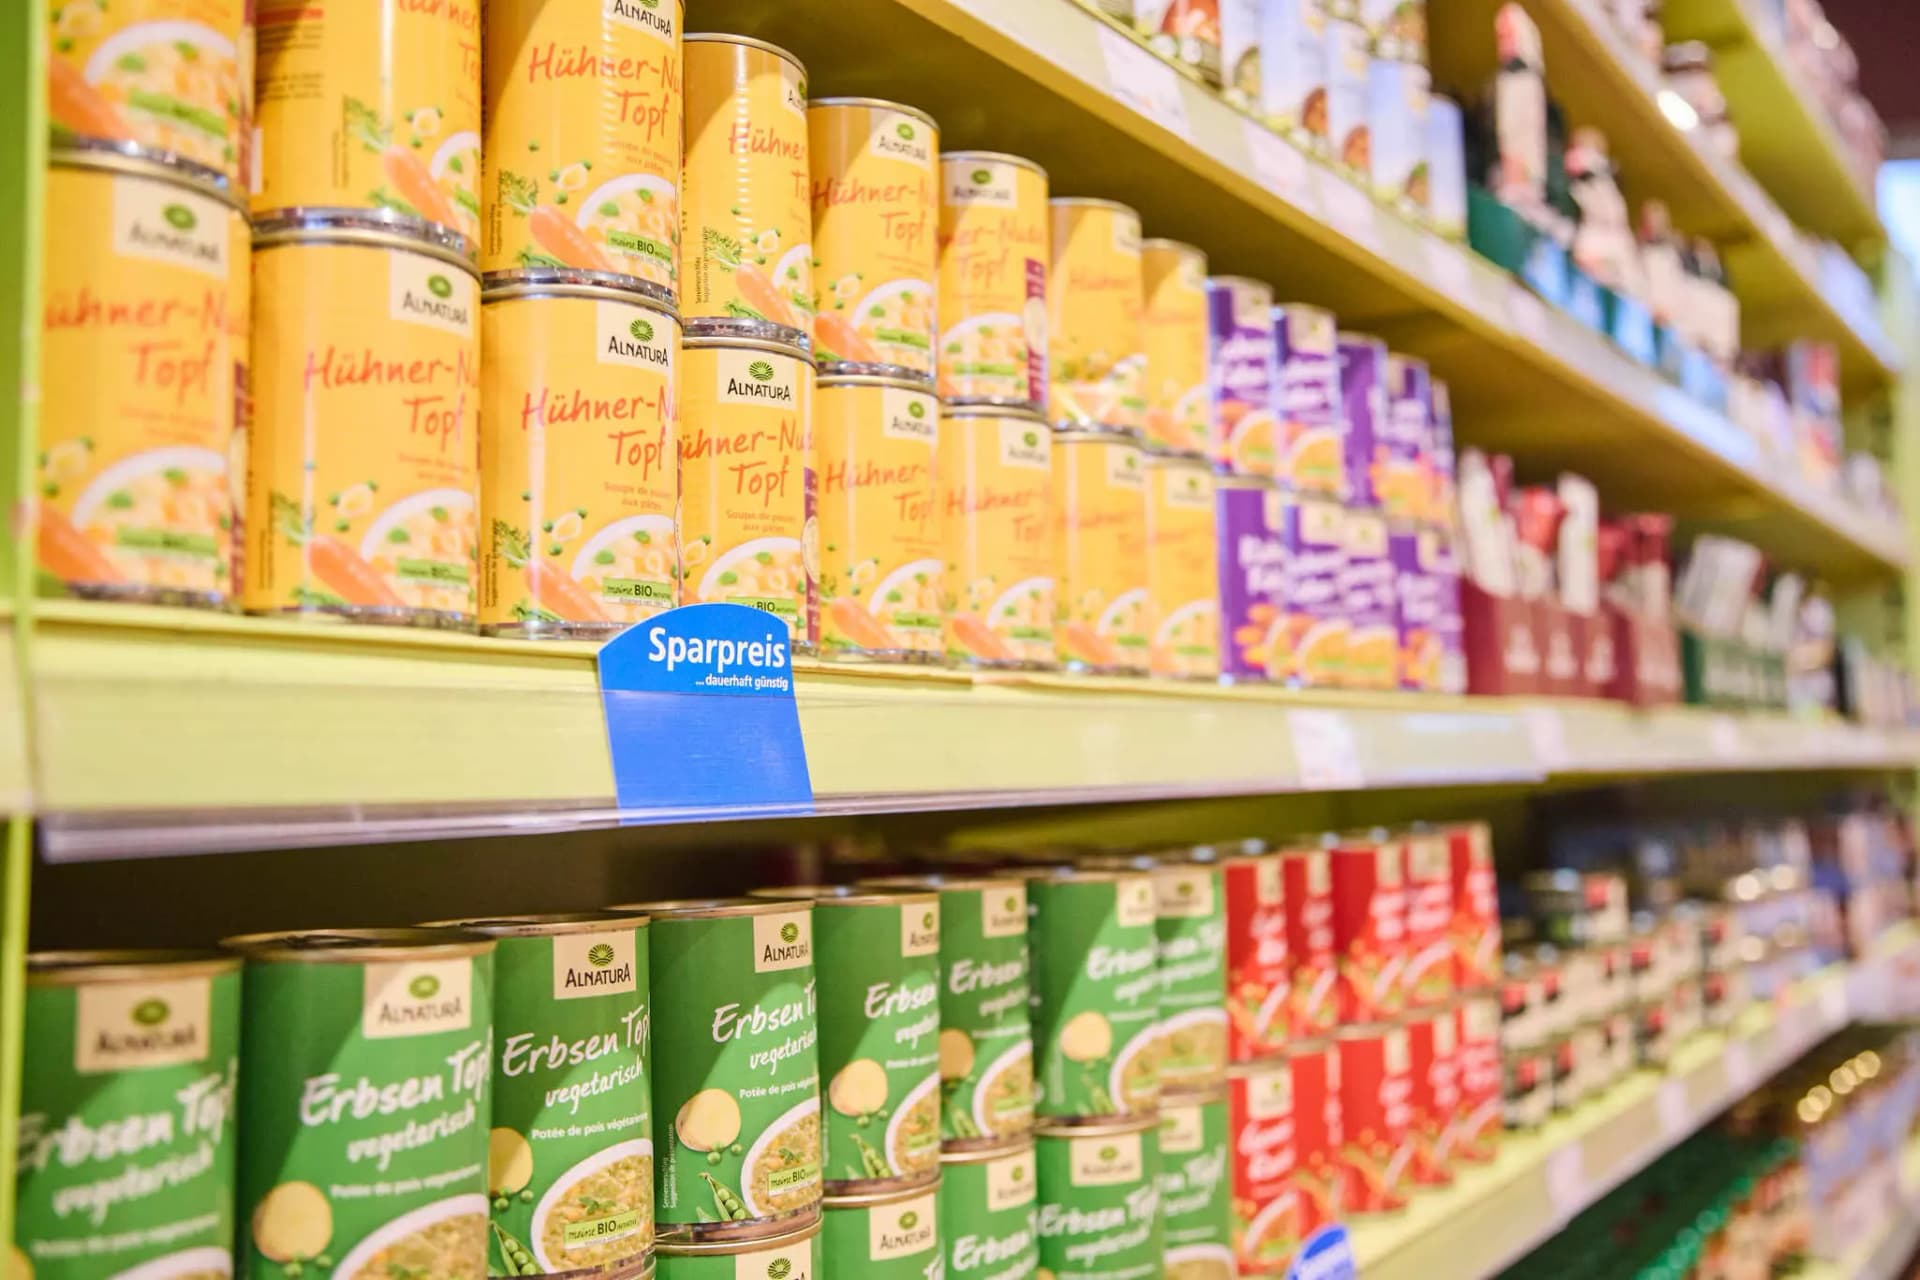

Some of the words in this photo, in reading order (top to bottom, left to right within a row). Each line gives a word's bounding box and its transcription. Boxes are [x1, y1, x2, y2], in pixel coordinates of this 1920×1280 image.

[614, 0, 672, 38] ALNATURA
[616, 90, 669, 142] Topf
[637, 240, 655, 255] BIO
[608, 335, 669, 366] ALNATURA
[128, 338, 216, 407] Topf
[727, 377, 791, 401] ALNATURA
[402, 393, 466, 454] Topf
[608, 423, 666, 482] Topf
[728, 455, 790, 508] Topf
[634, 584, 652, 597] BIO
[757, 602, 775, 613] BIO
[649, 626, 785, 673] Sparpreis
[755, 675, 789, 692] günstig
[763, 939, 809, 963] ALNATURA
[565, 962, 631, 988] ALNATURA
[379, 998, 464, 1026] ALNATURA
[712, 1003, 804, 1043] Erbsen
[502, 1032, 619, 1077] Erbsen
[545, 1054, 643, 1114] vegetarisch
[300, 1073, 443, 1127] Erbsen
[567, 1124, 582, 1136] de
[792, 1169, 806, 1183] BIO
[597, 1220, 617, 1235] BIO
